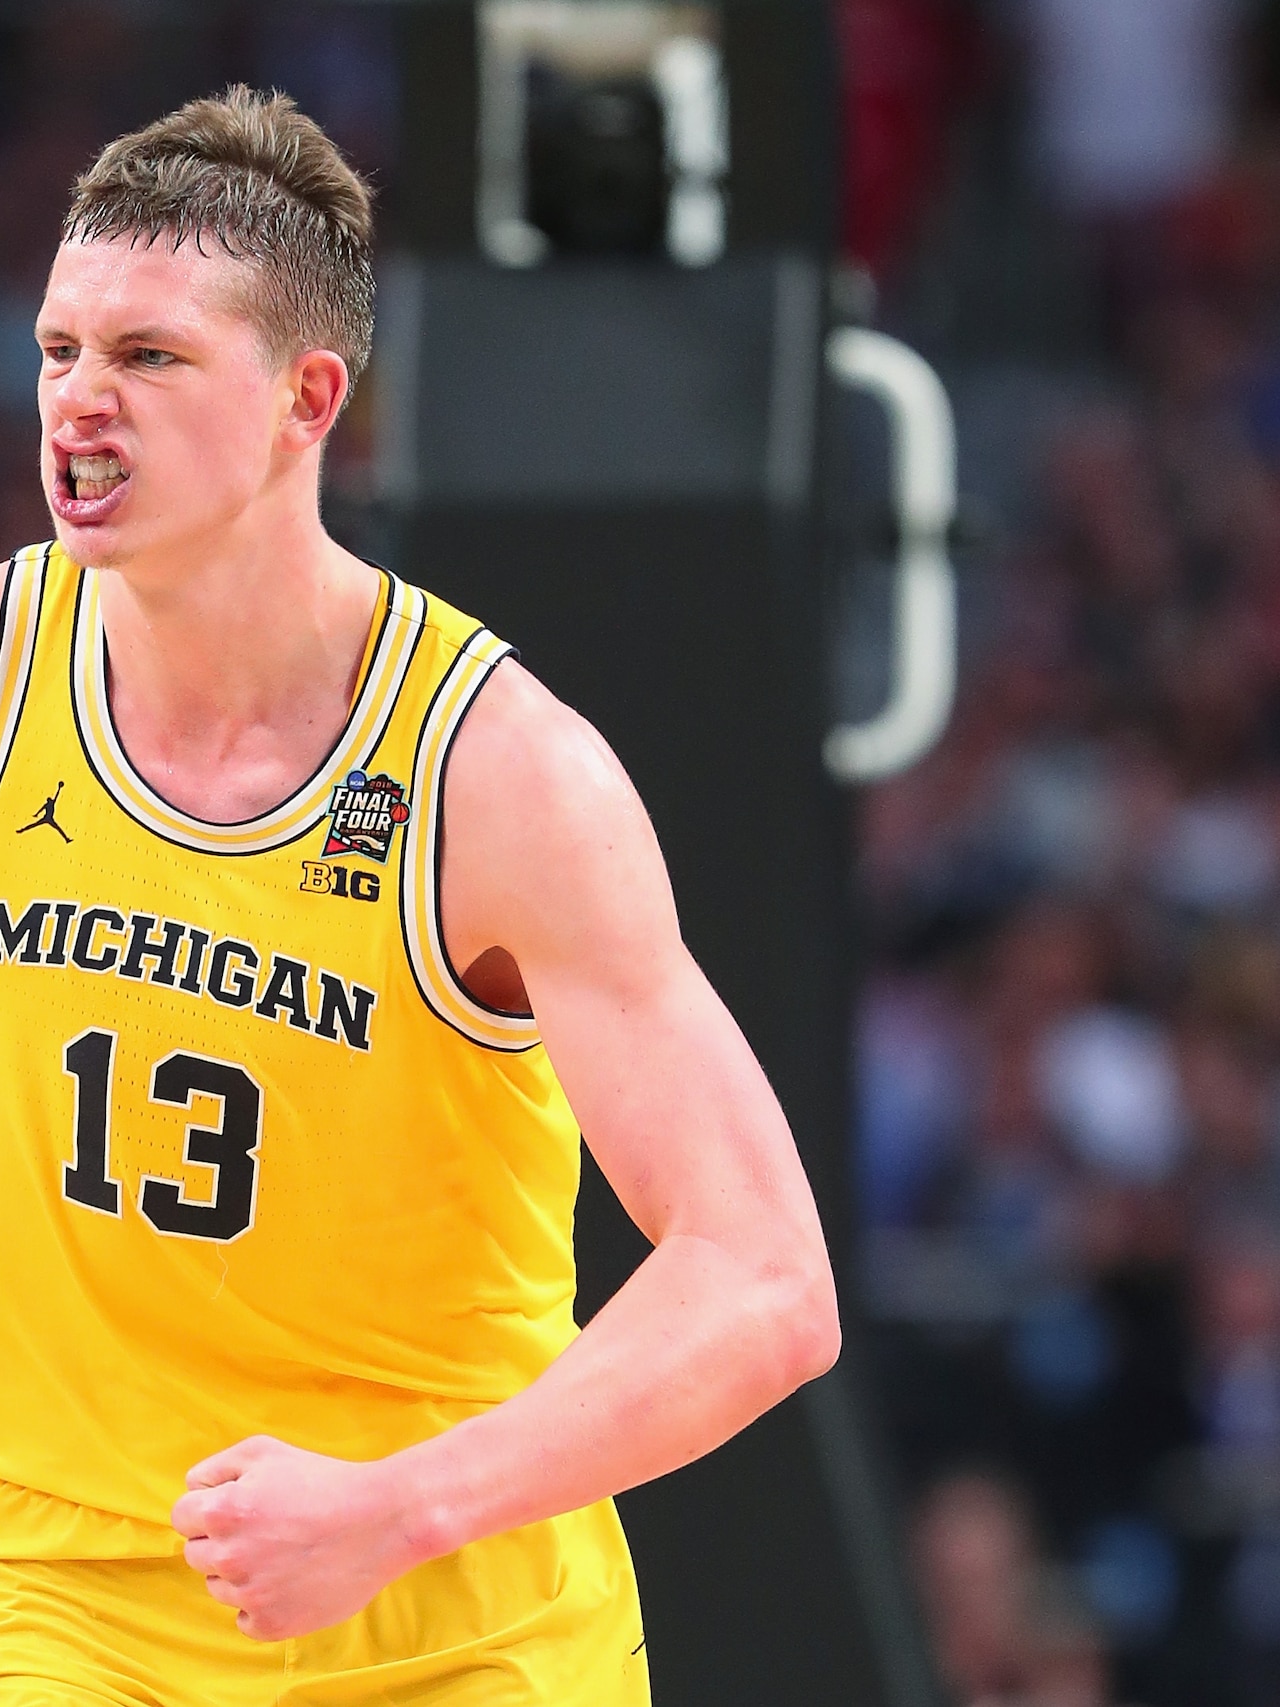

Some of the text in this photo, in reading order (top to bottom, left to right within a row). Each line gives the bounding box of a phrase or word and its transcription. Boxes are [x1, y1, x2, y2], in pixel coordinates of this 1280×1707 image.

[331, 788, 392, 812] FINAL
[334, 810, 392, 831] FOUR
[62, 1026, 264, 1245] 13
